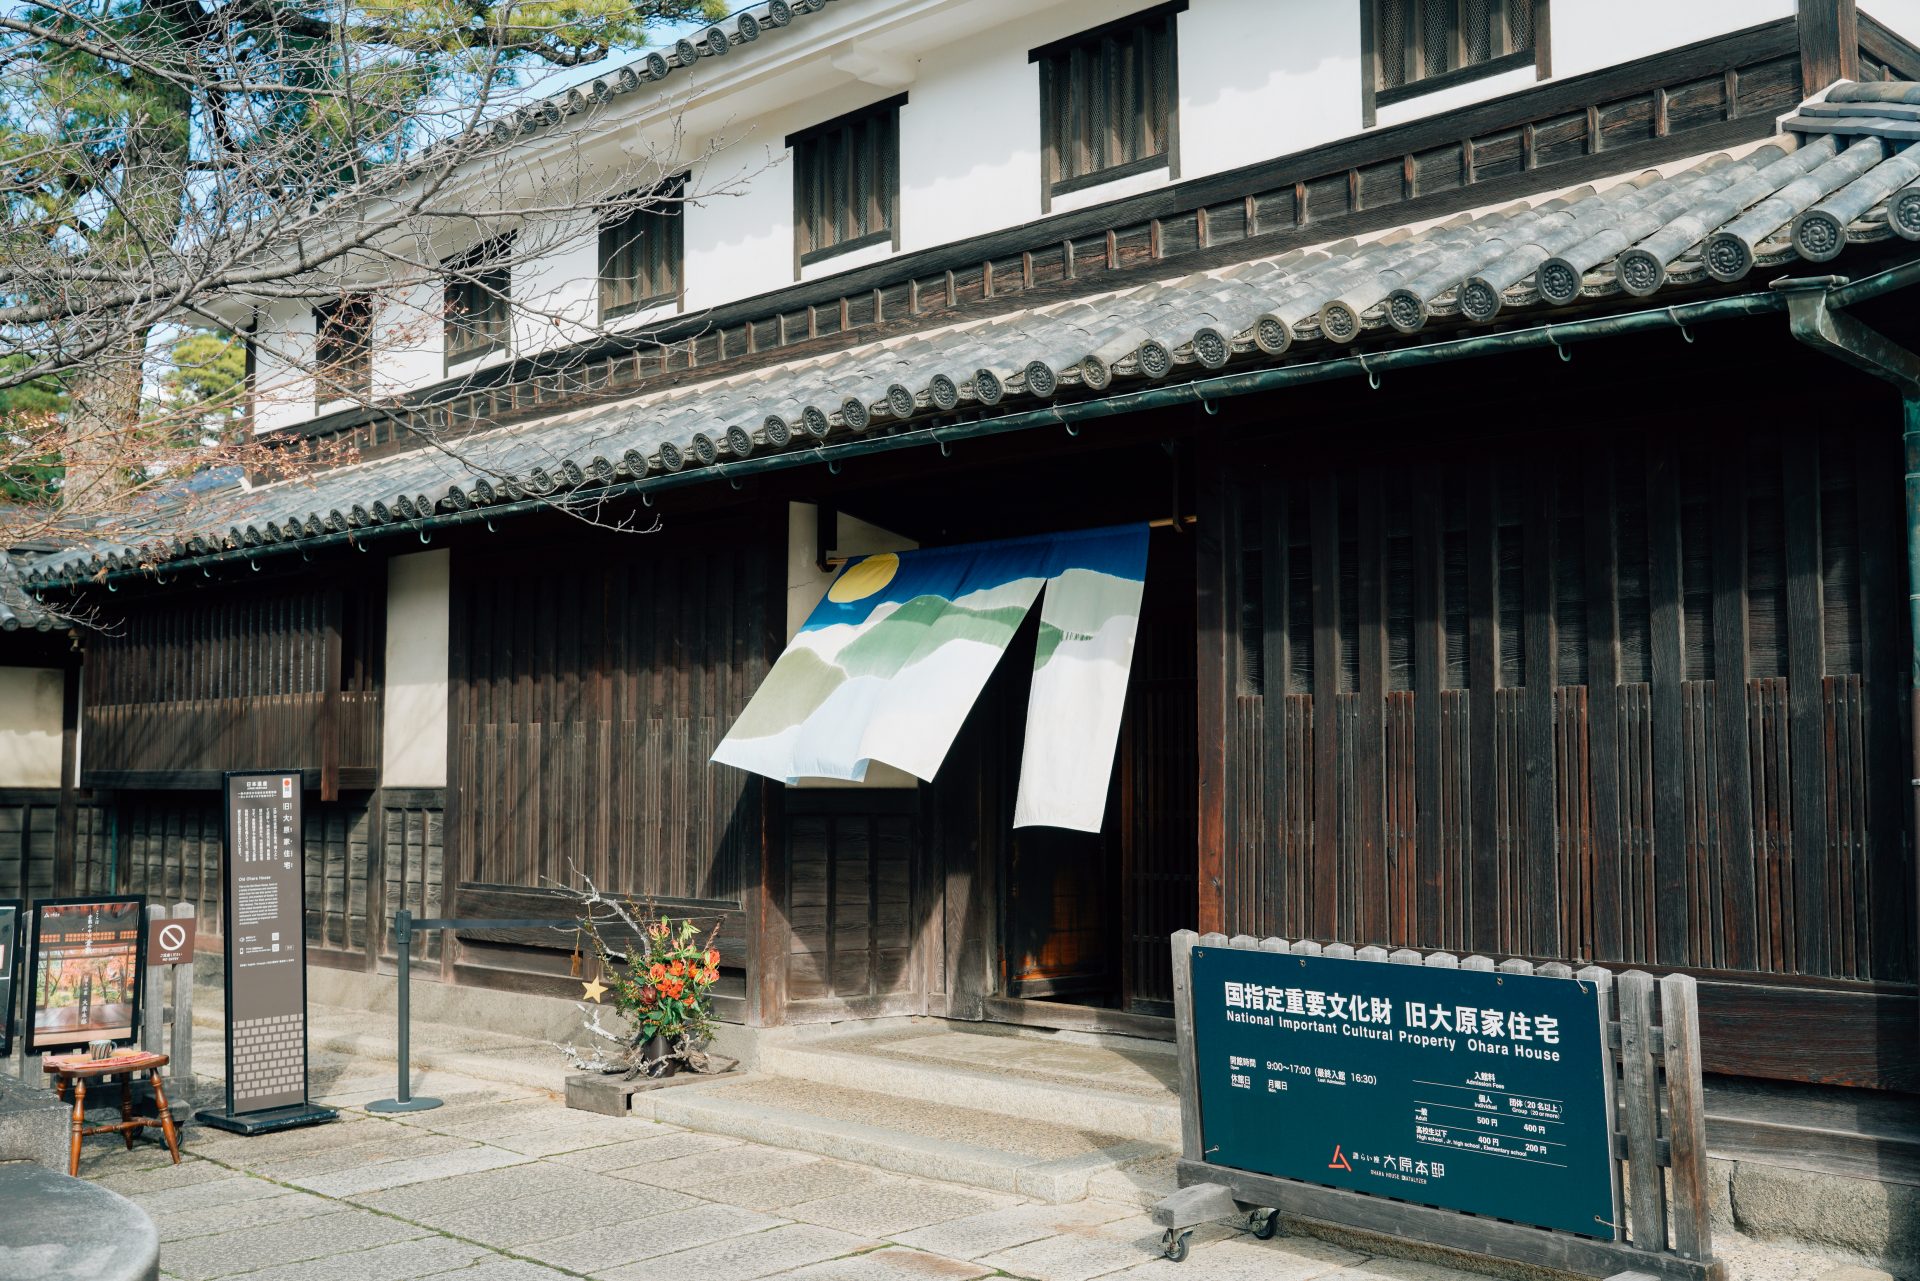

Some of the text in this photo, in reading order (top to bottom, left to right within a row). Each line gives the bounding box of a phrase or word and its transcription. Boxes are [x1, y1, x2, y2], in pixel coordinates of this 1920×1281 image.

[1224, 981, 1560, 1044] 国指定重要文化財 旧大原家住宅
[1226, 1010, 1560, 1062] National Important Cultural Property Ohara House
[1231, 1073, 1288, 1091] 休館日 月曜日
[1474, 1071, 1496, 1083] 入館料
[1478, 1094, 1493, 1104] 個人
[1474, 1102, 1498, 1111] Individual
[1511, 1107, 1528, 1115] Group
[1416, 1125, 1448, 1138] 高校生以下
[1383, 1154, 1445, 1179] 大原本邸
